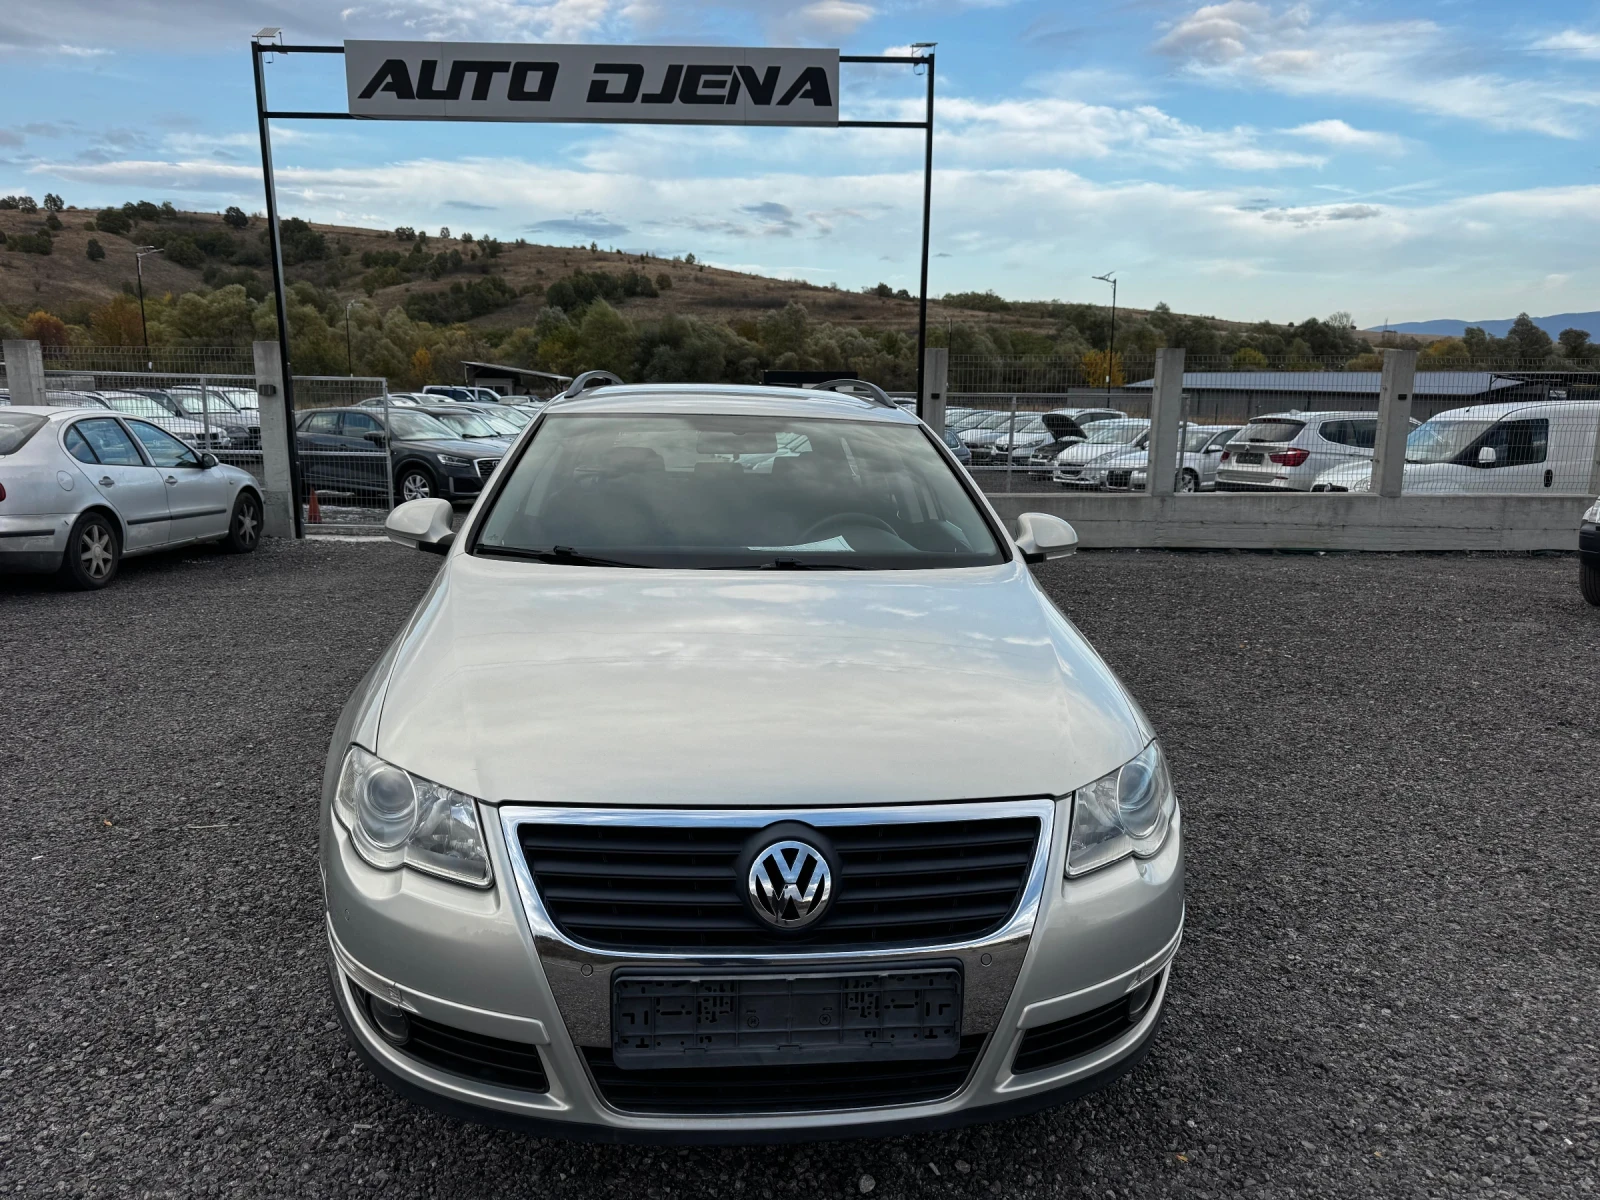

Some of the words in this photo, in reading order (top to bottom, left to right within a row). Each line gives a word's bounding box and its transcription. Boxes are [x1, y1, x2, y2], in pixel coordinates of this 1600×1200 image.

[357, 58, 560, 102] AUTO
[585, 63, 833, 107] DJENA
[749, 840, 832, 928] VW
